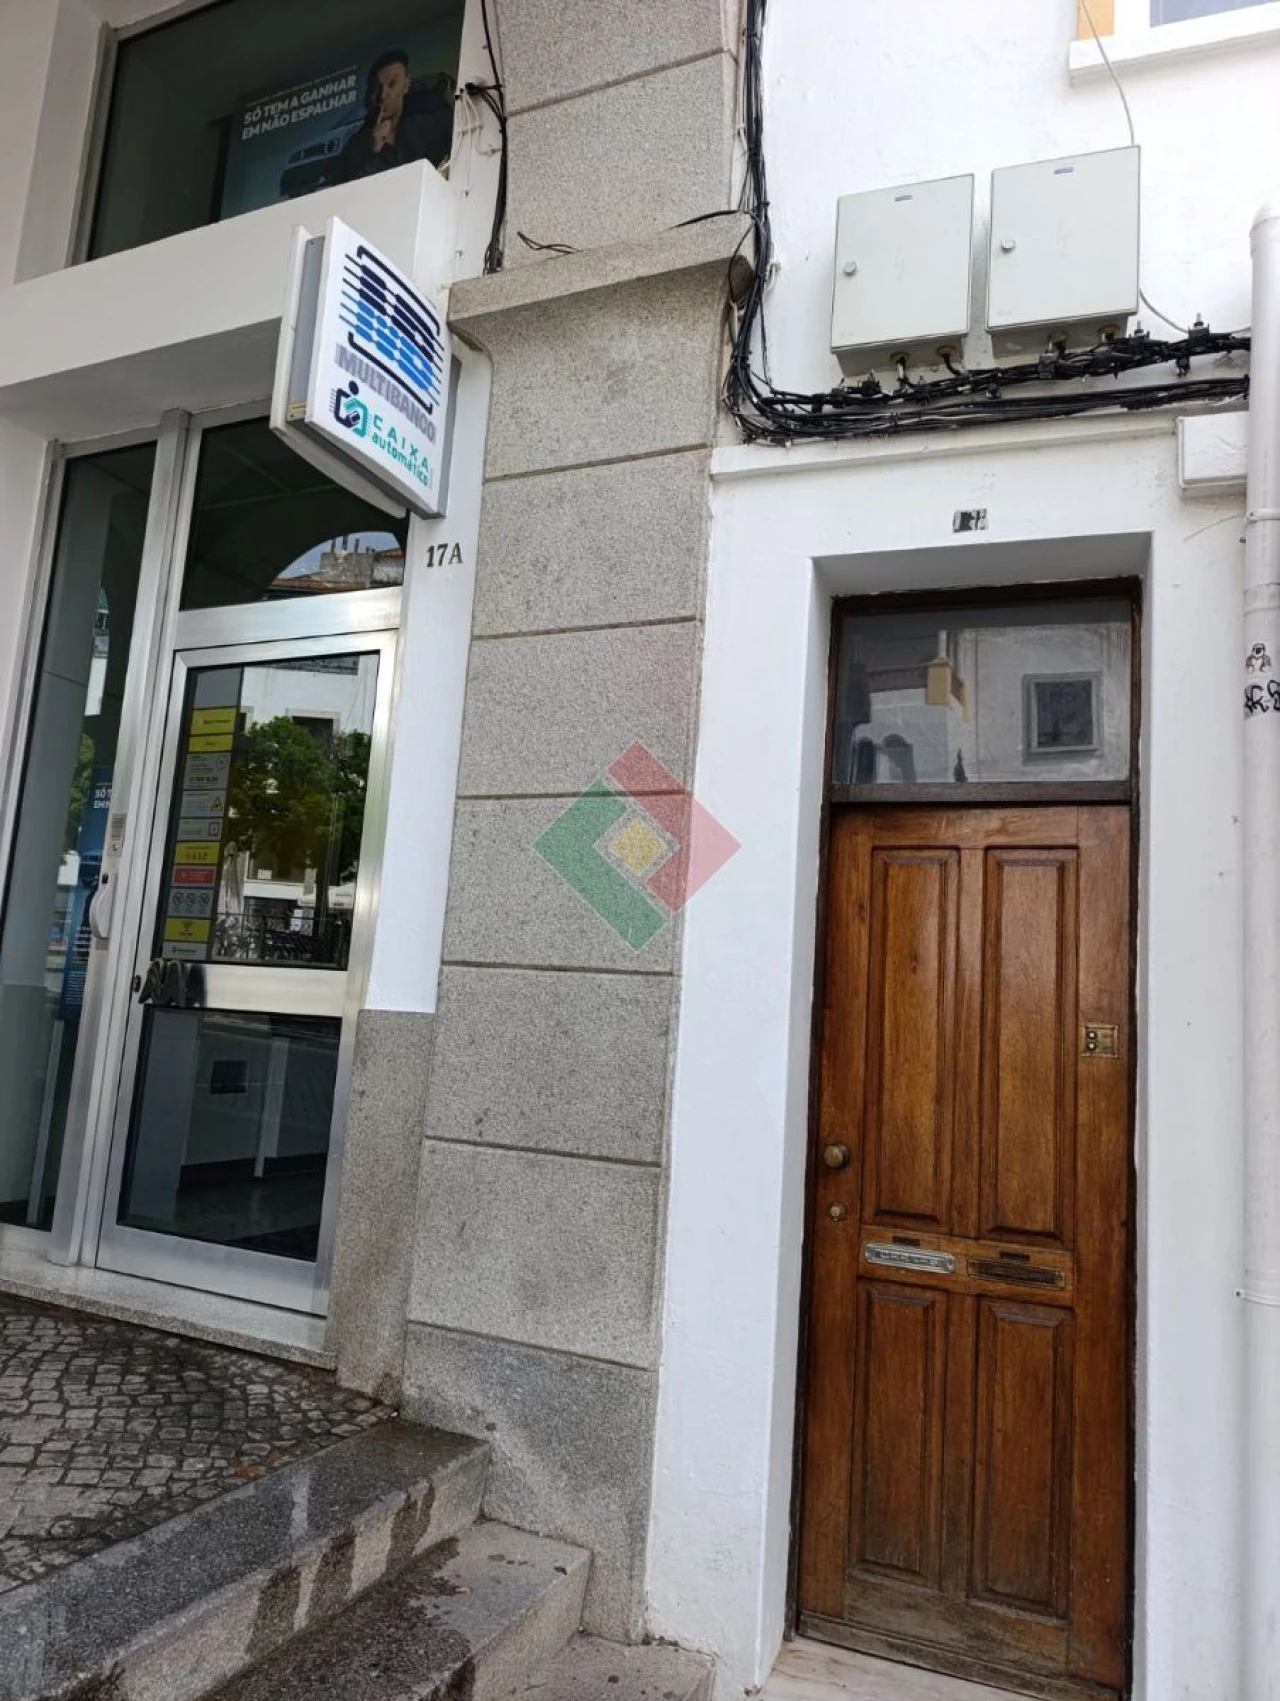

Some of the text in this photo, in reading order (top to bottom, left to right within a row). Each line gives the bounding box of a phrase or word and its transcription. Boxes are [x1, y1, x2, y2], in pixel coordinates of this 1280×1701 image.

[241, 90, 356, 140] EM NÃO ESPALHAR
[244, 75, 356, 125] SÓ TEM A GANHAR
[334, 342, 437, 446] MULTIBANCO
[371, 431, 429, 487] automático
[372, 414, 429, 473] CAIXA
[426, 542, 463, 568] 17A
